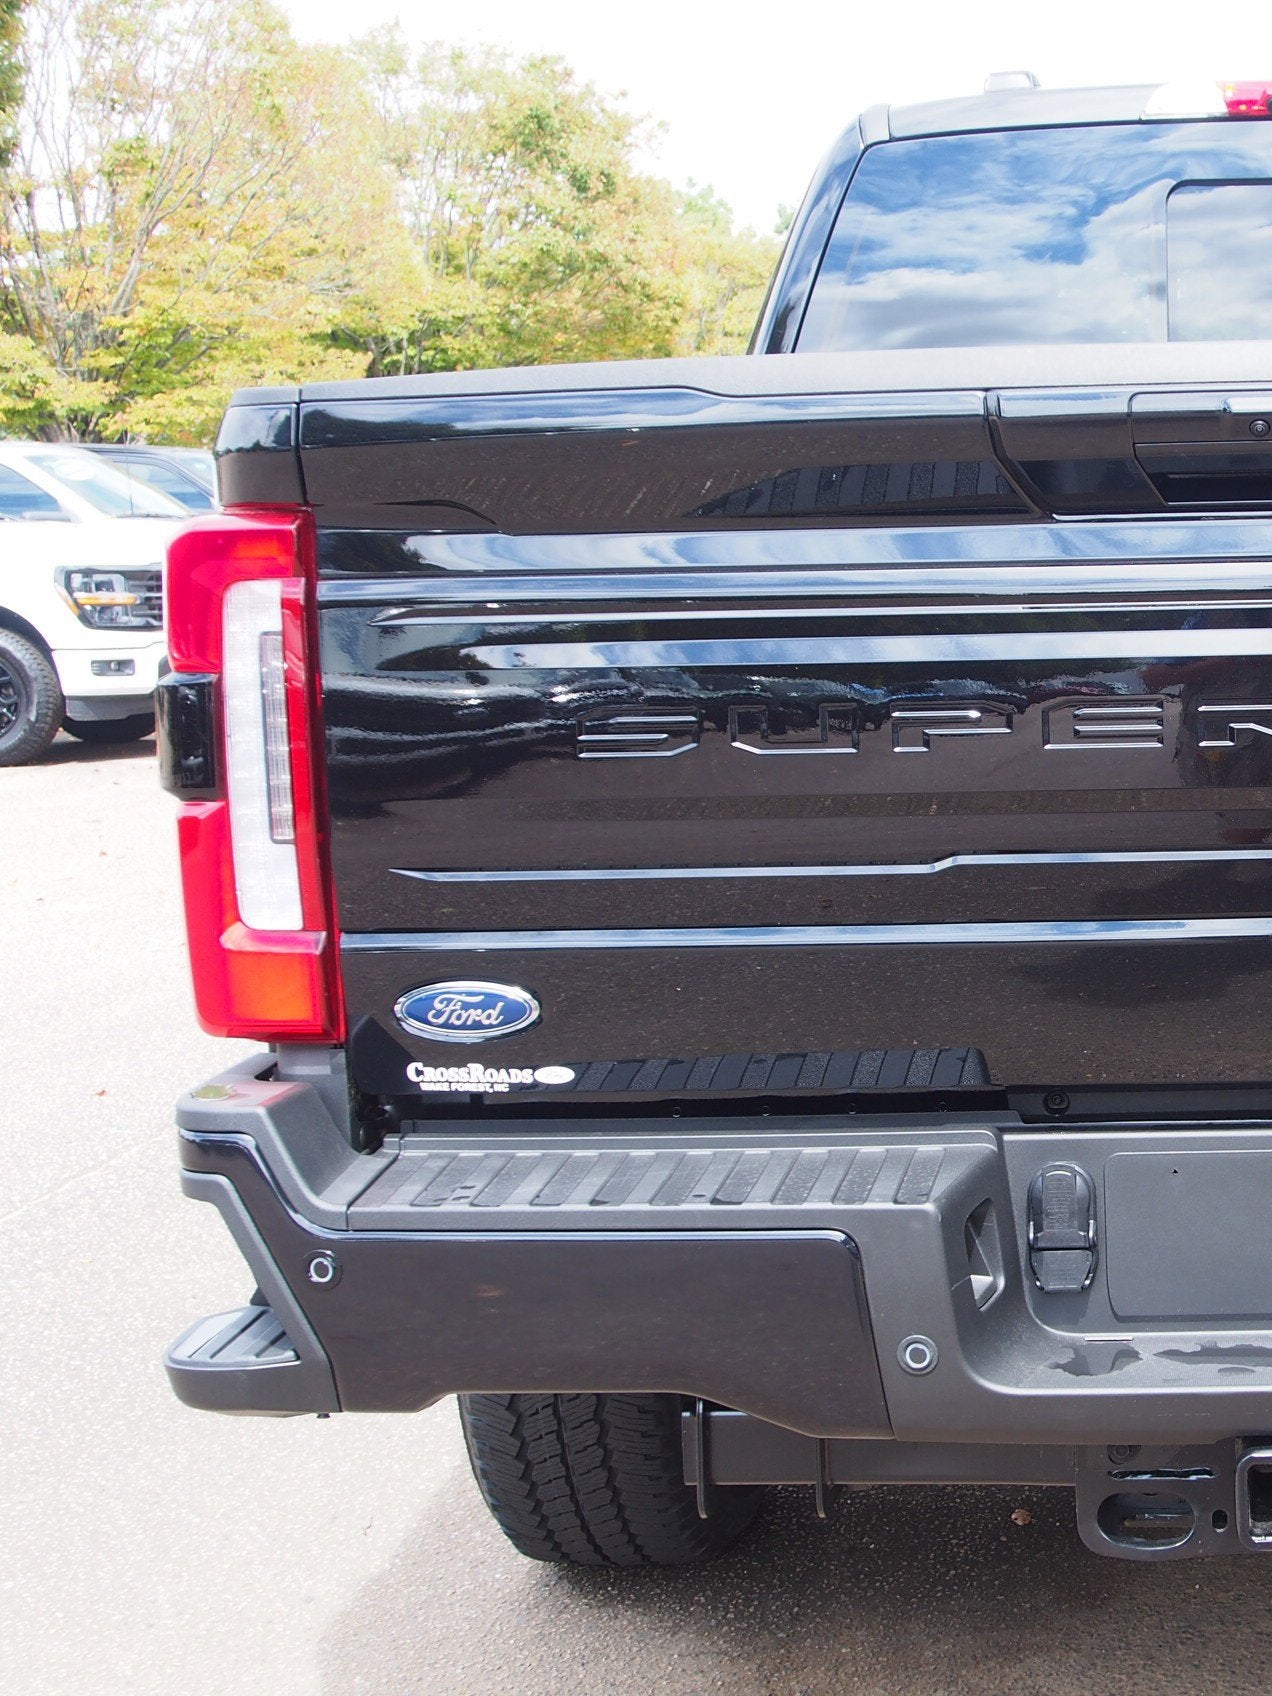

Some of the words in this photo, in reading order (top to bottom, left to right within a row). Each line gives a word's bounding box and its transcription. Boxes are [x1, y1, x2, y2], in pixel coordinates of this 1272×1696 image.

[427, 993, 504, 1026] Ford
[420, 1082, 450, 1091] WAKE
[451, 1082, 493, 1093] FOREST,
[494, 1083, 509, 1092] NC
